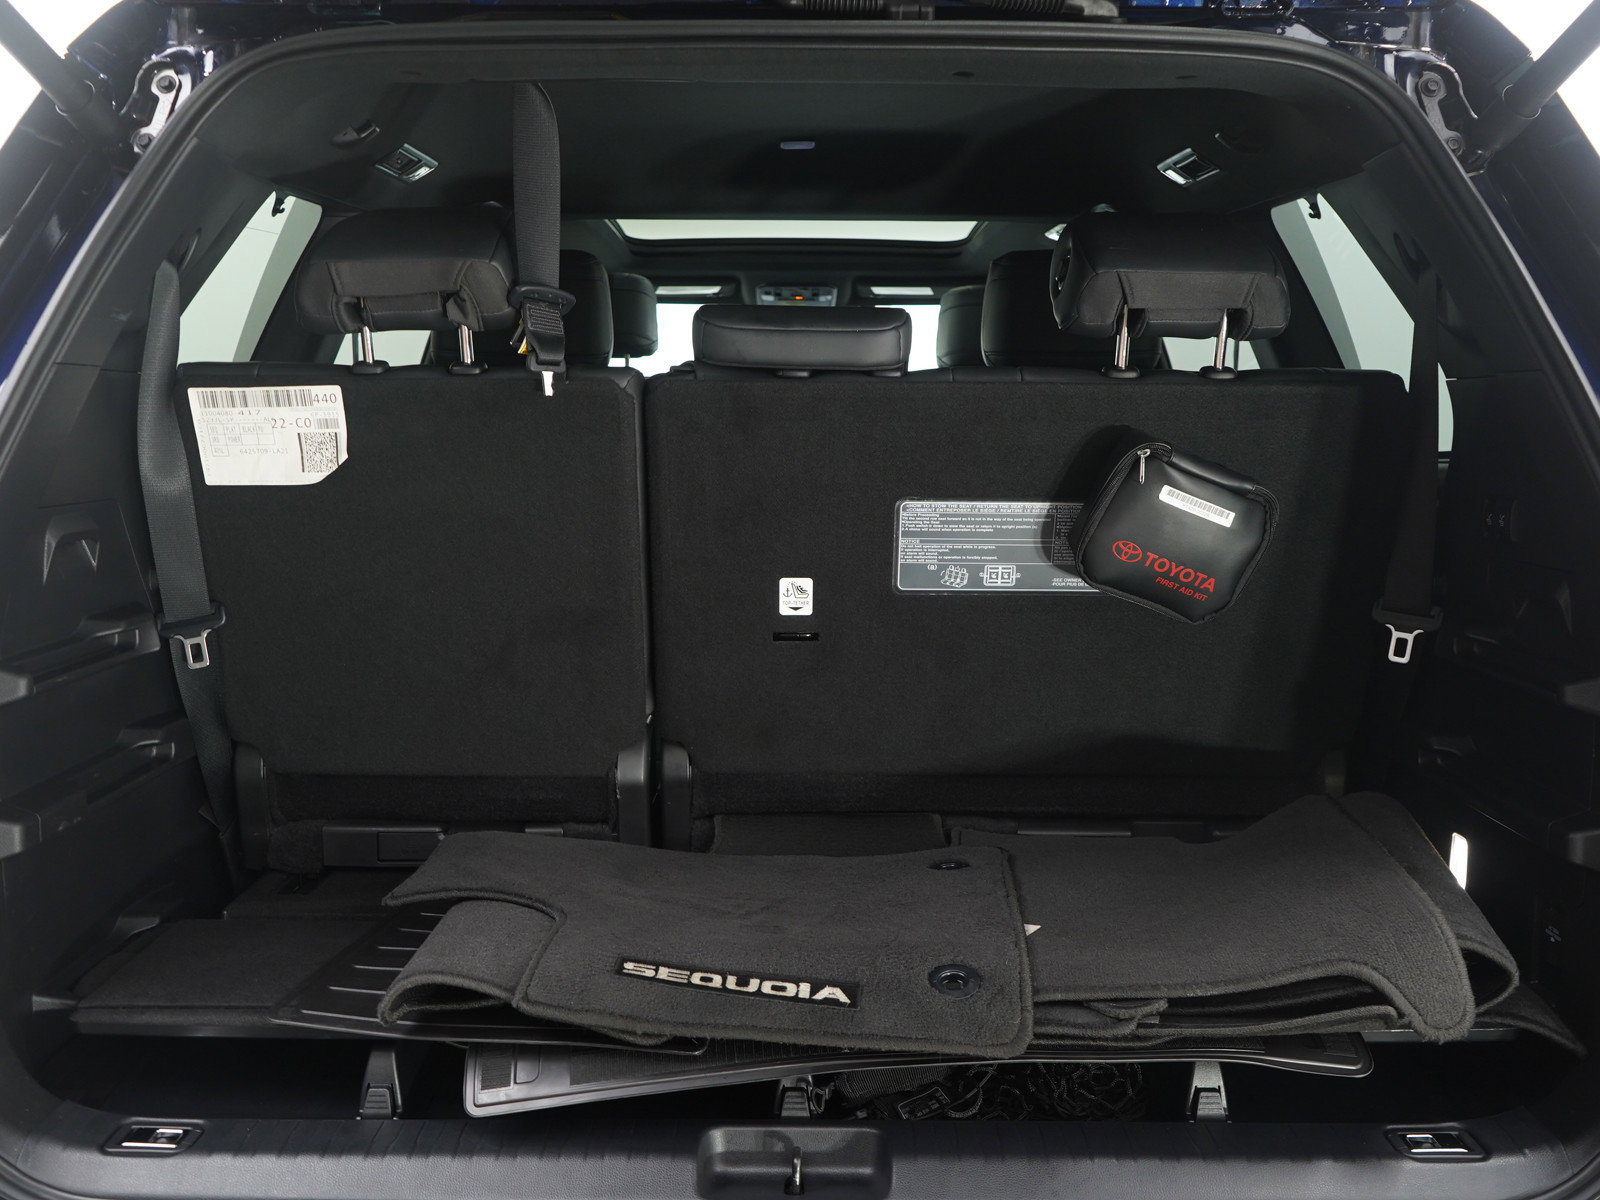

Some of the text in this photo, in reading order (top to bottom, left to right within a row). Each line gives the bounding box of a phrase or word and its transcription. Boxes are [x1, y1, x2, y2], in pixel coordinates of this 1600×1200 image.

[312, 393, 337, 404] 440
[1144, 552, 1215, 592] TOYOTA
[1155, 577, 1208, 601] FIRST AID KIT
[623, 961, 851, 1006] SEQUOIA
